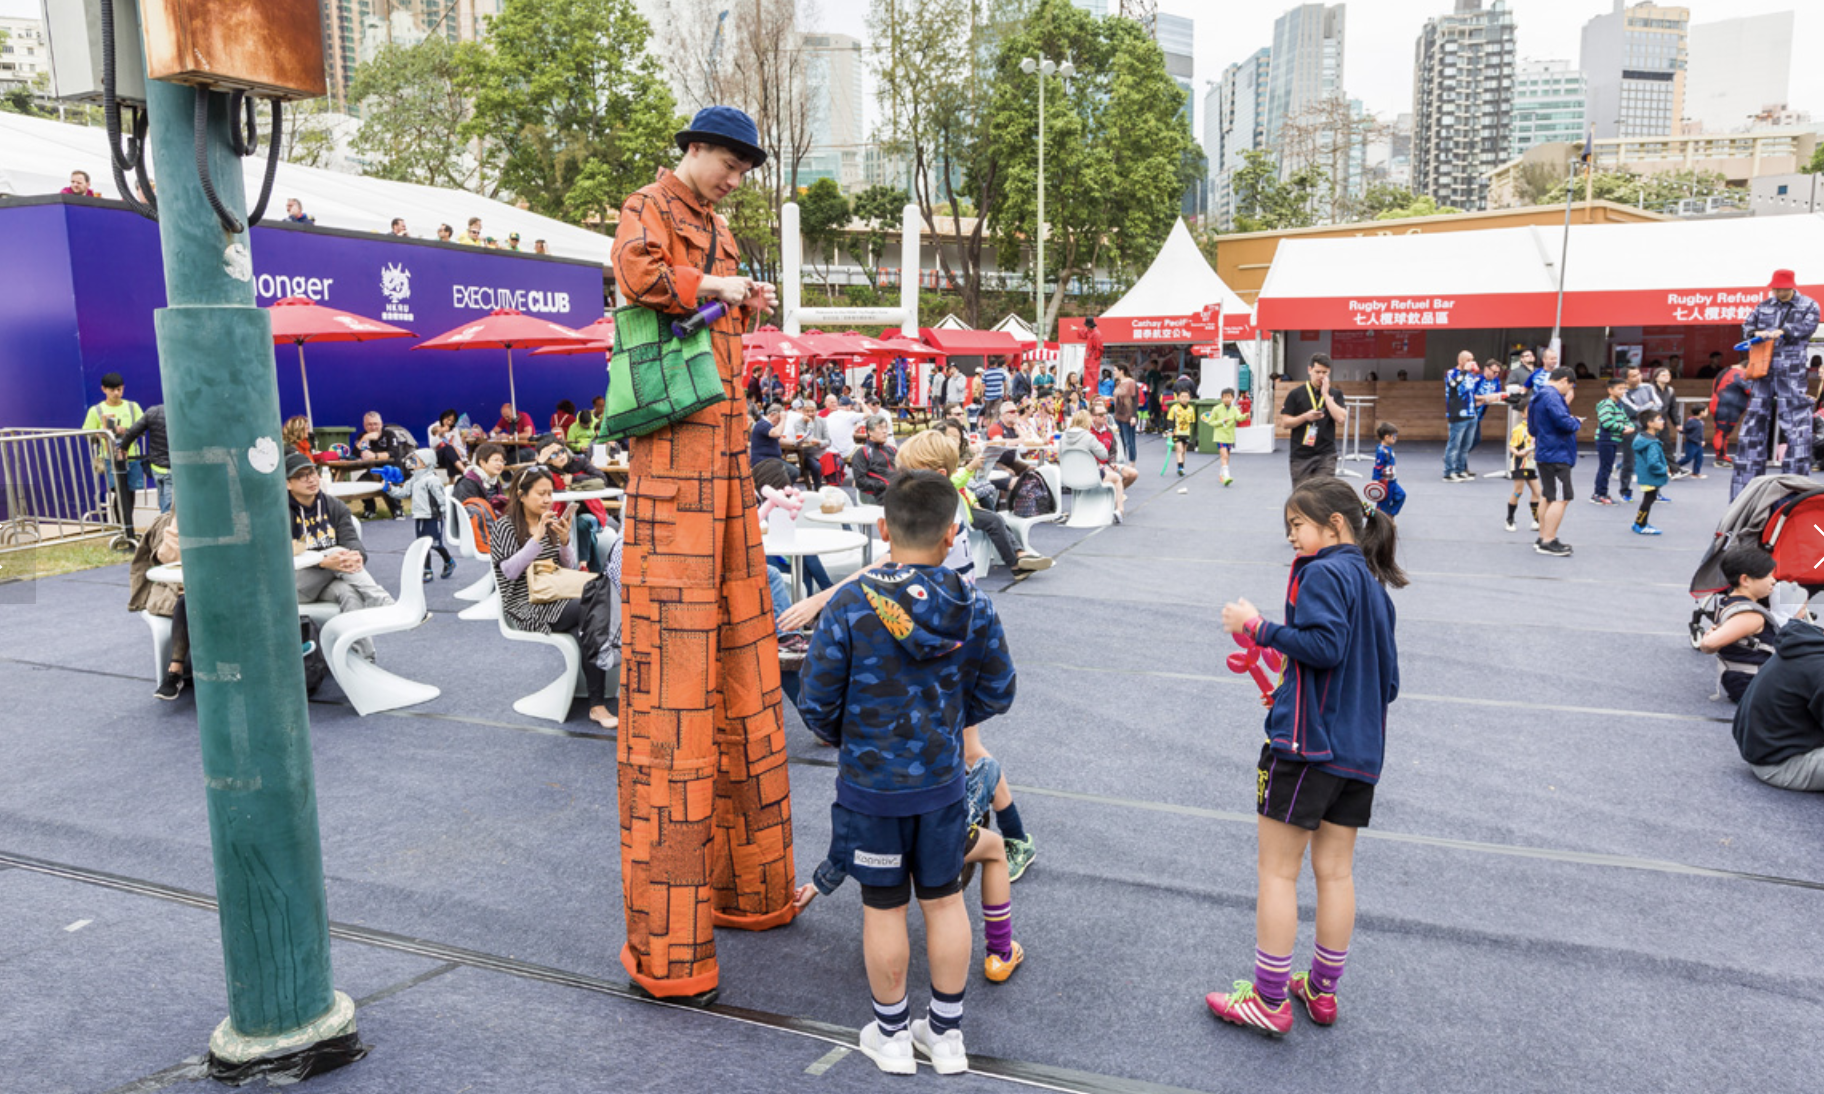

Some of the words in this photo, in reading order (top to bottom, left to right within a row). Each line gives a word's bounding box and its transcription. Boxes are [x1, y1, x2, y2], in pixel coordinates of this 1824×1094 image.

[453, 285, 526, 311] EXECUTIVE
[527, 290, 570, 313] CLUB
[1349, 300, 1388, 312] Rugby
[1391, 299, 1430, 310] Refuel
[1433, 298, 1455, 309] Bar
[1668, 292, 1713, 306] Rugby
[1717, 291, 1763, 303] Refuel
[1672, 305, 1753, 321] 七人欖球飲
[1132, 319, 1162, 330] Cathay
[1164, 318, 1192, 328] Pacif
